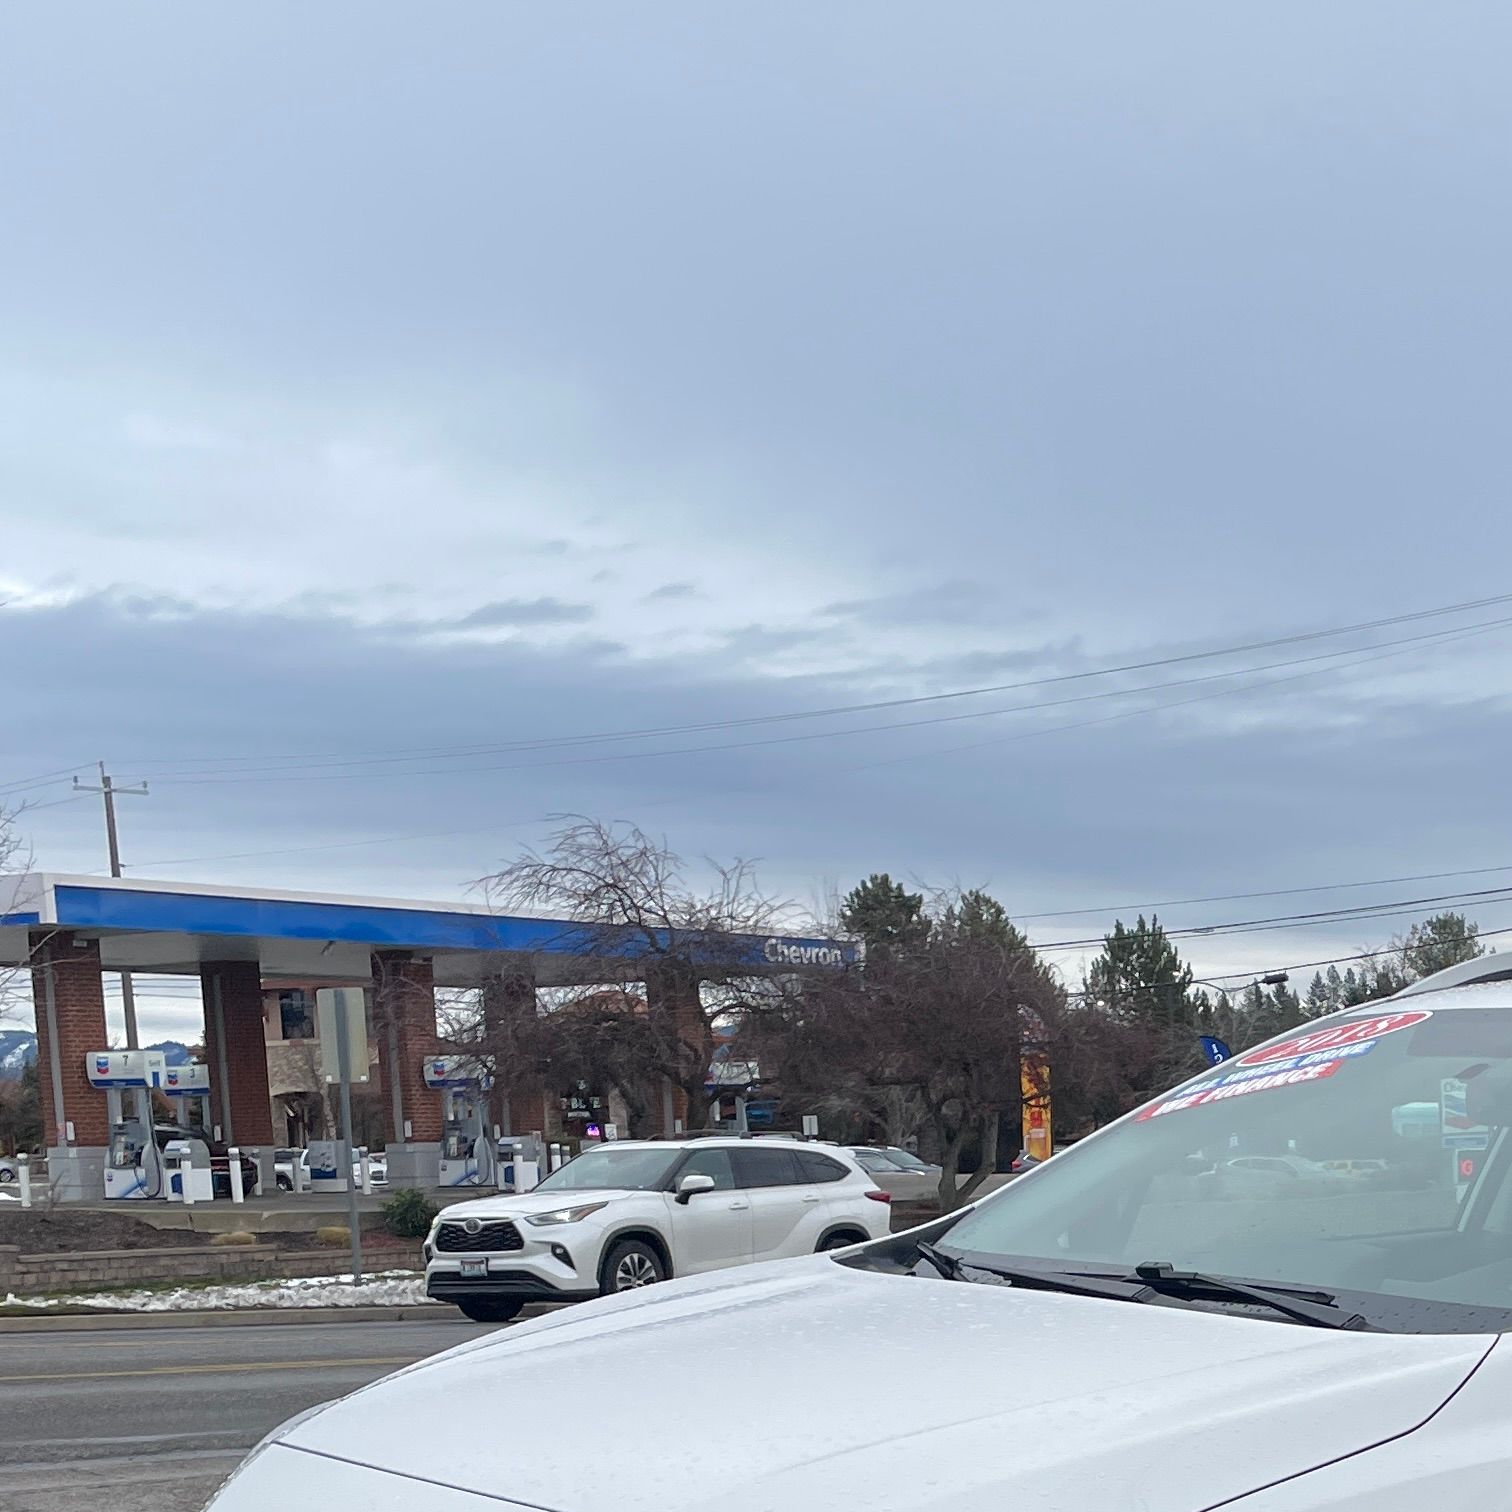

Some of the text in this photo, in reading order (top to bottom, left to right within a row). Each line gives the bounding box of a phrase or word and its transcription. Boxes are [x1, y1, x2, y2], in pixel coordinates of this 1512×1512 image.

[764, 938, 842, 965] Chevron
[1260, 1015, 1406, 1061] 2018
[1220, 1057, 1302, 1086] WHEEL
[1298, 1040, 1378, 1067] DRIVE
[1151, 1062, 1334, 1117] WE FINANCE
